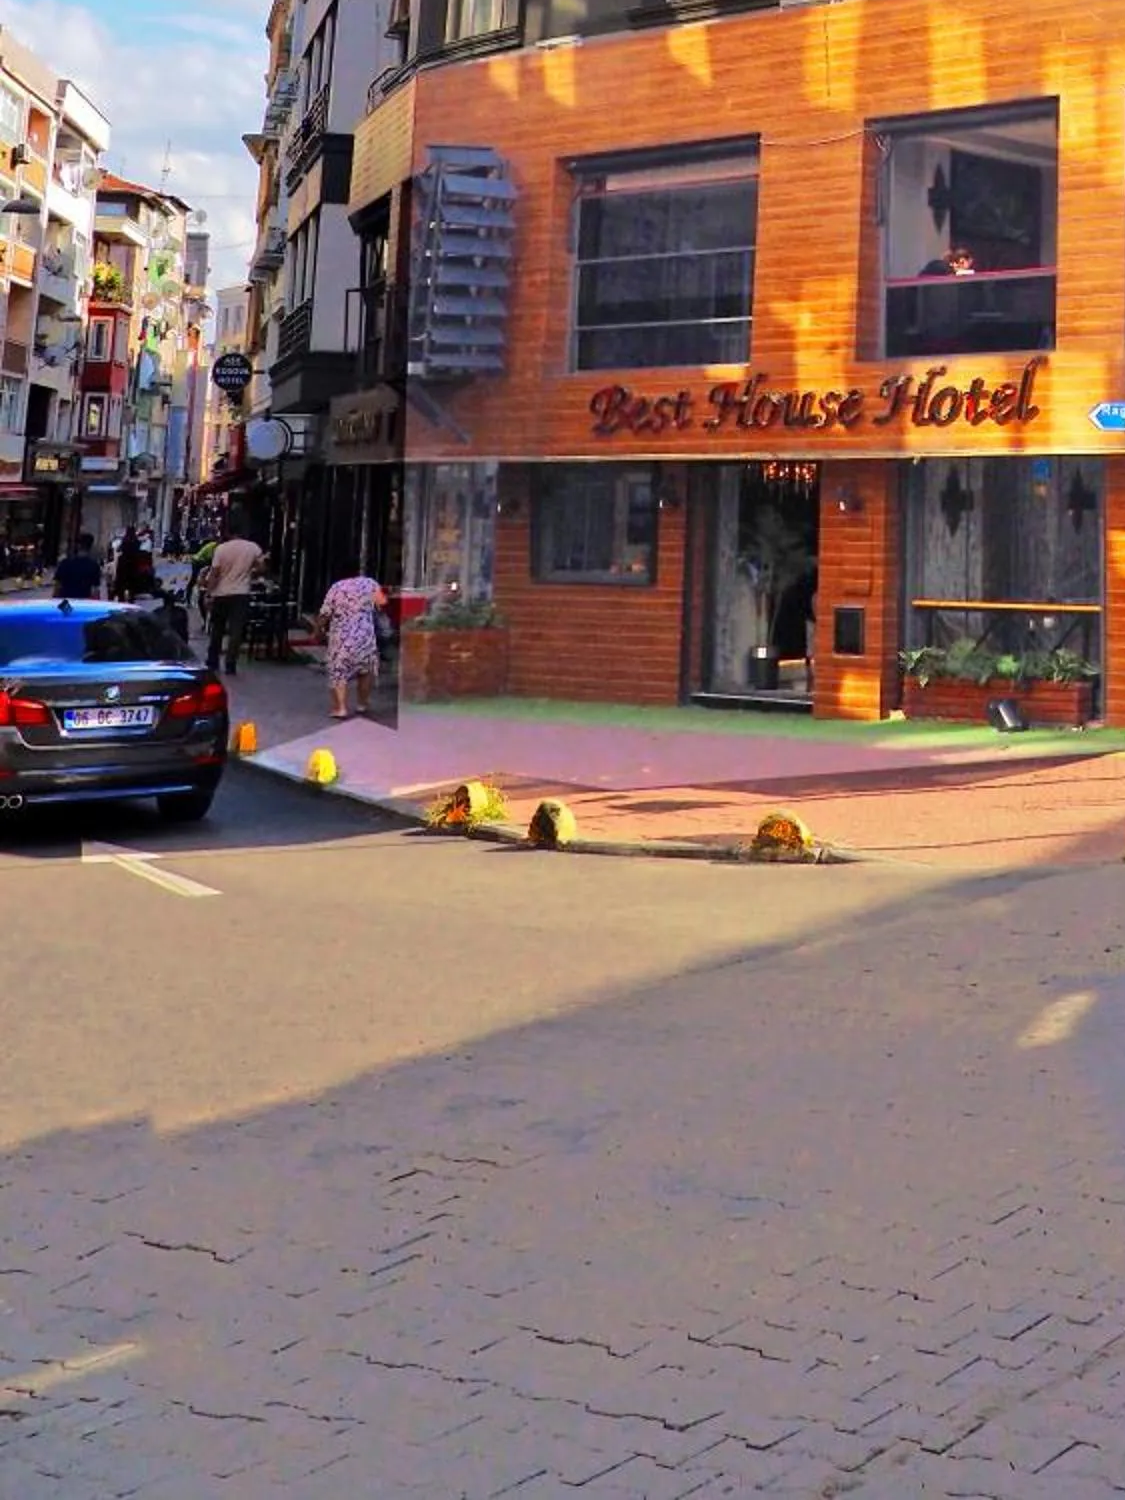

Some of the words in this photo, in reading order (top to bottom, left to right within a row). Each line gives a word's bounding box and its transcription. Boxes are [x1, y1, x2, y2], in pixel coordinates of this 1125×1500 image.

[589, 384, 694, 435] Best
[702, 372, 864, 434] House
[873, 355, 1048, 428] Hotel
